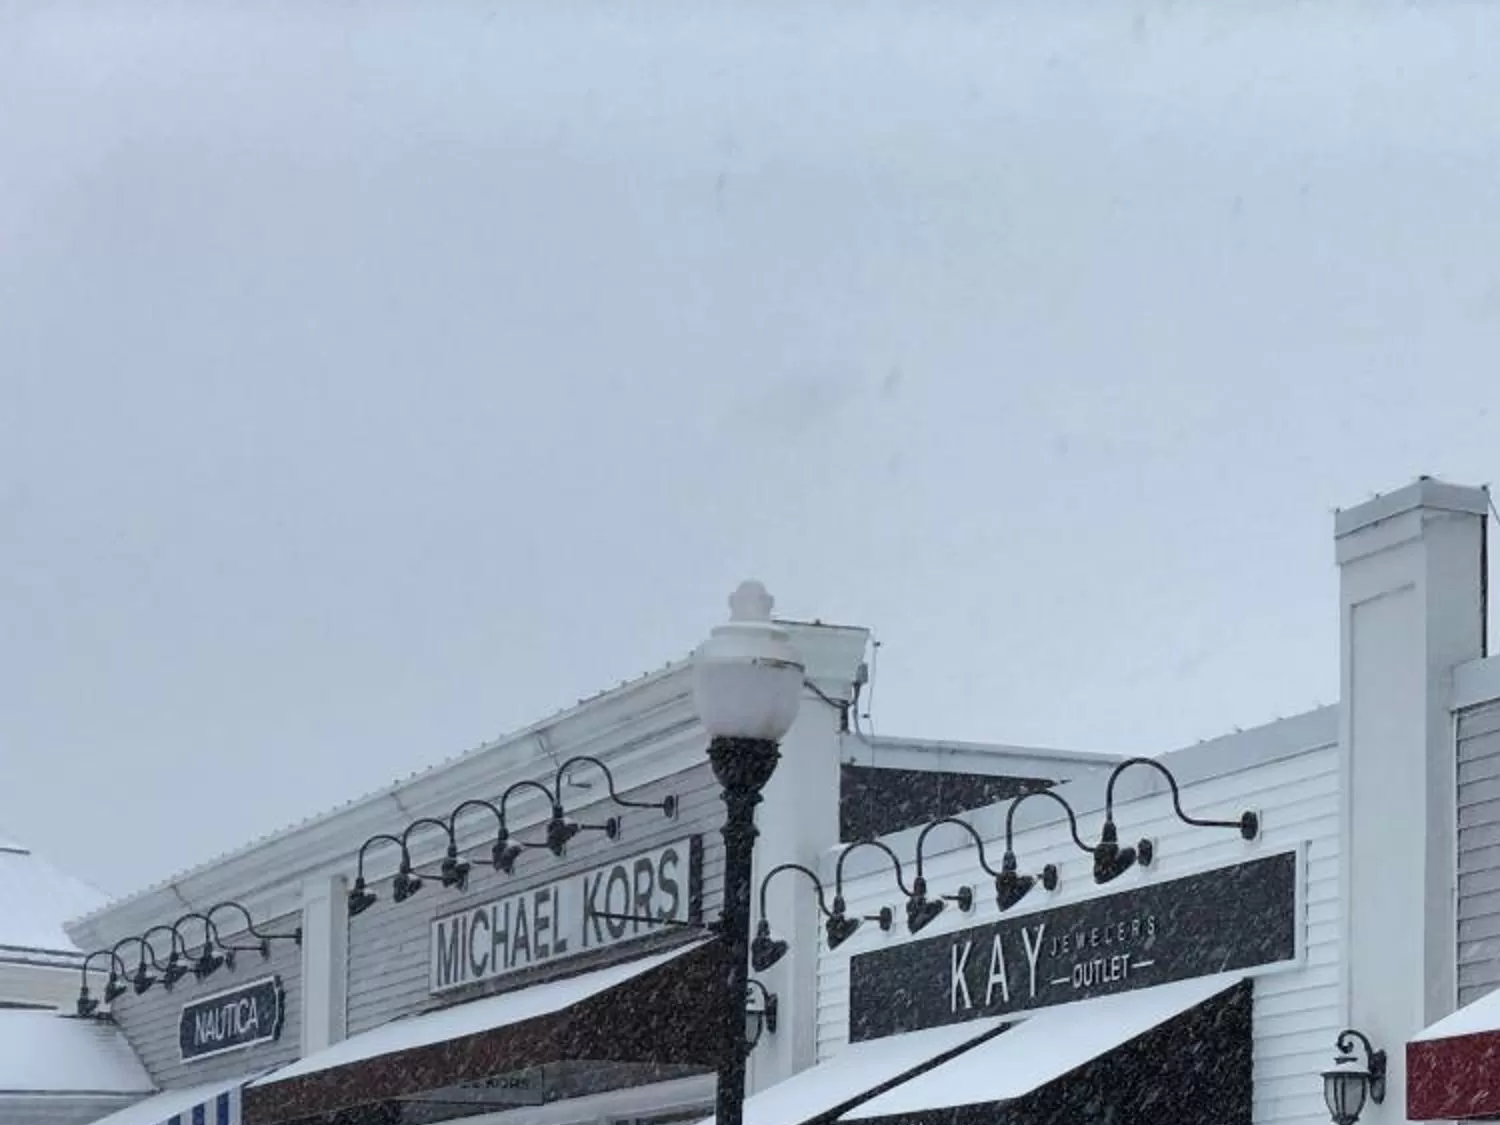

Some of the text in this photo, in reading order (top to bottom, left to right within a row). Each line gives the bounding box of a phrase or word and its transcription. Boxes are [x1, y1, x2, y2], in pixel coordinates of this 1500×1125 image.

[437, 848, 679, 986] MICHAEL KORS
[1051, 915, 1155, 956] JEWELERS
[951, 923, 1045, 1013] KAY
[1072, 954, 1130, 988] OUTLET
[194, 997, 259, 1046] NAUTICA
